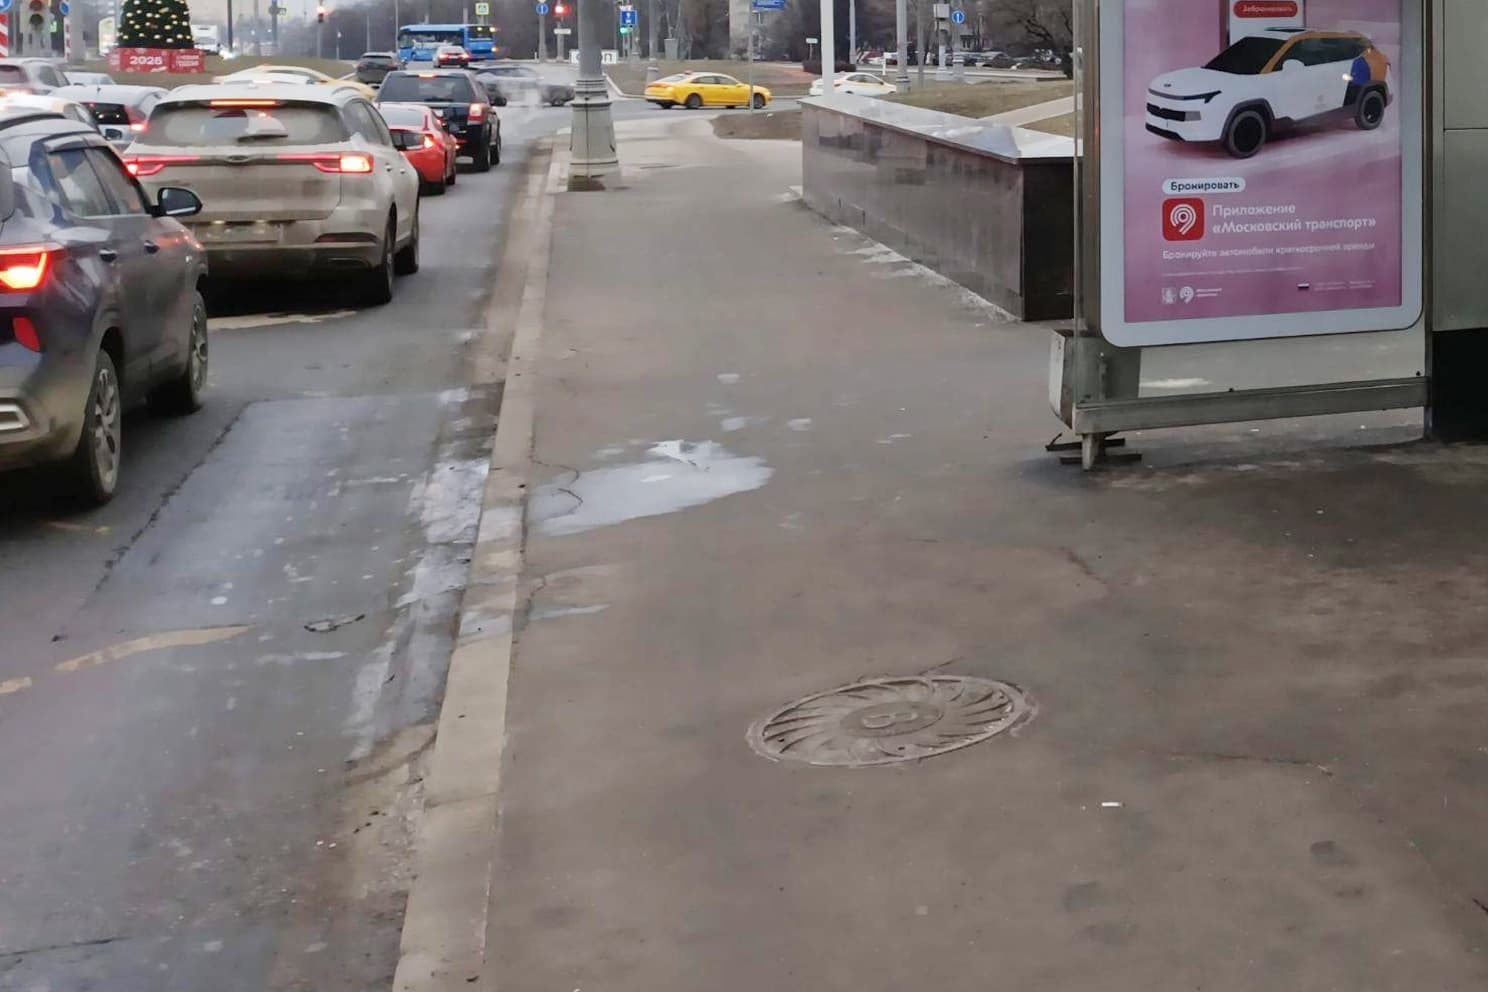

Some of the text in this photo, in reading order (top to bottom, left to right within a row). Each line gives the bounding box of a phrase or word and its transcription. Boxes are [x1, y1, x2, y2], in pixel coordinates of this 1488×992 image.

[1170, 181, 1240, 193] Бронировать
[1212, 204, 1296, 218] Приложение
[1212, 216, 1376, 234] «Московский транспорт»
